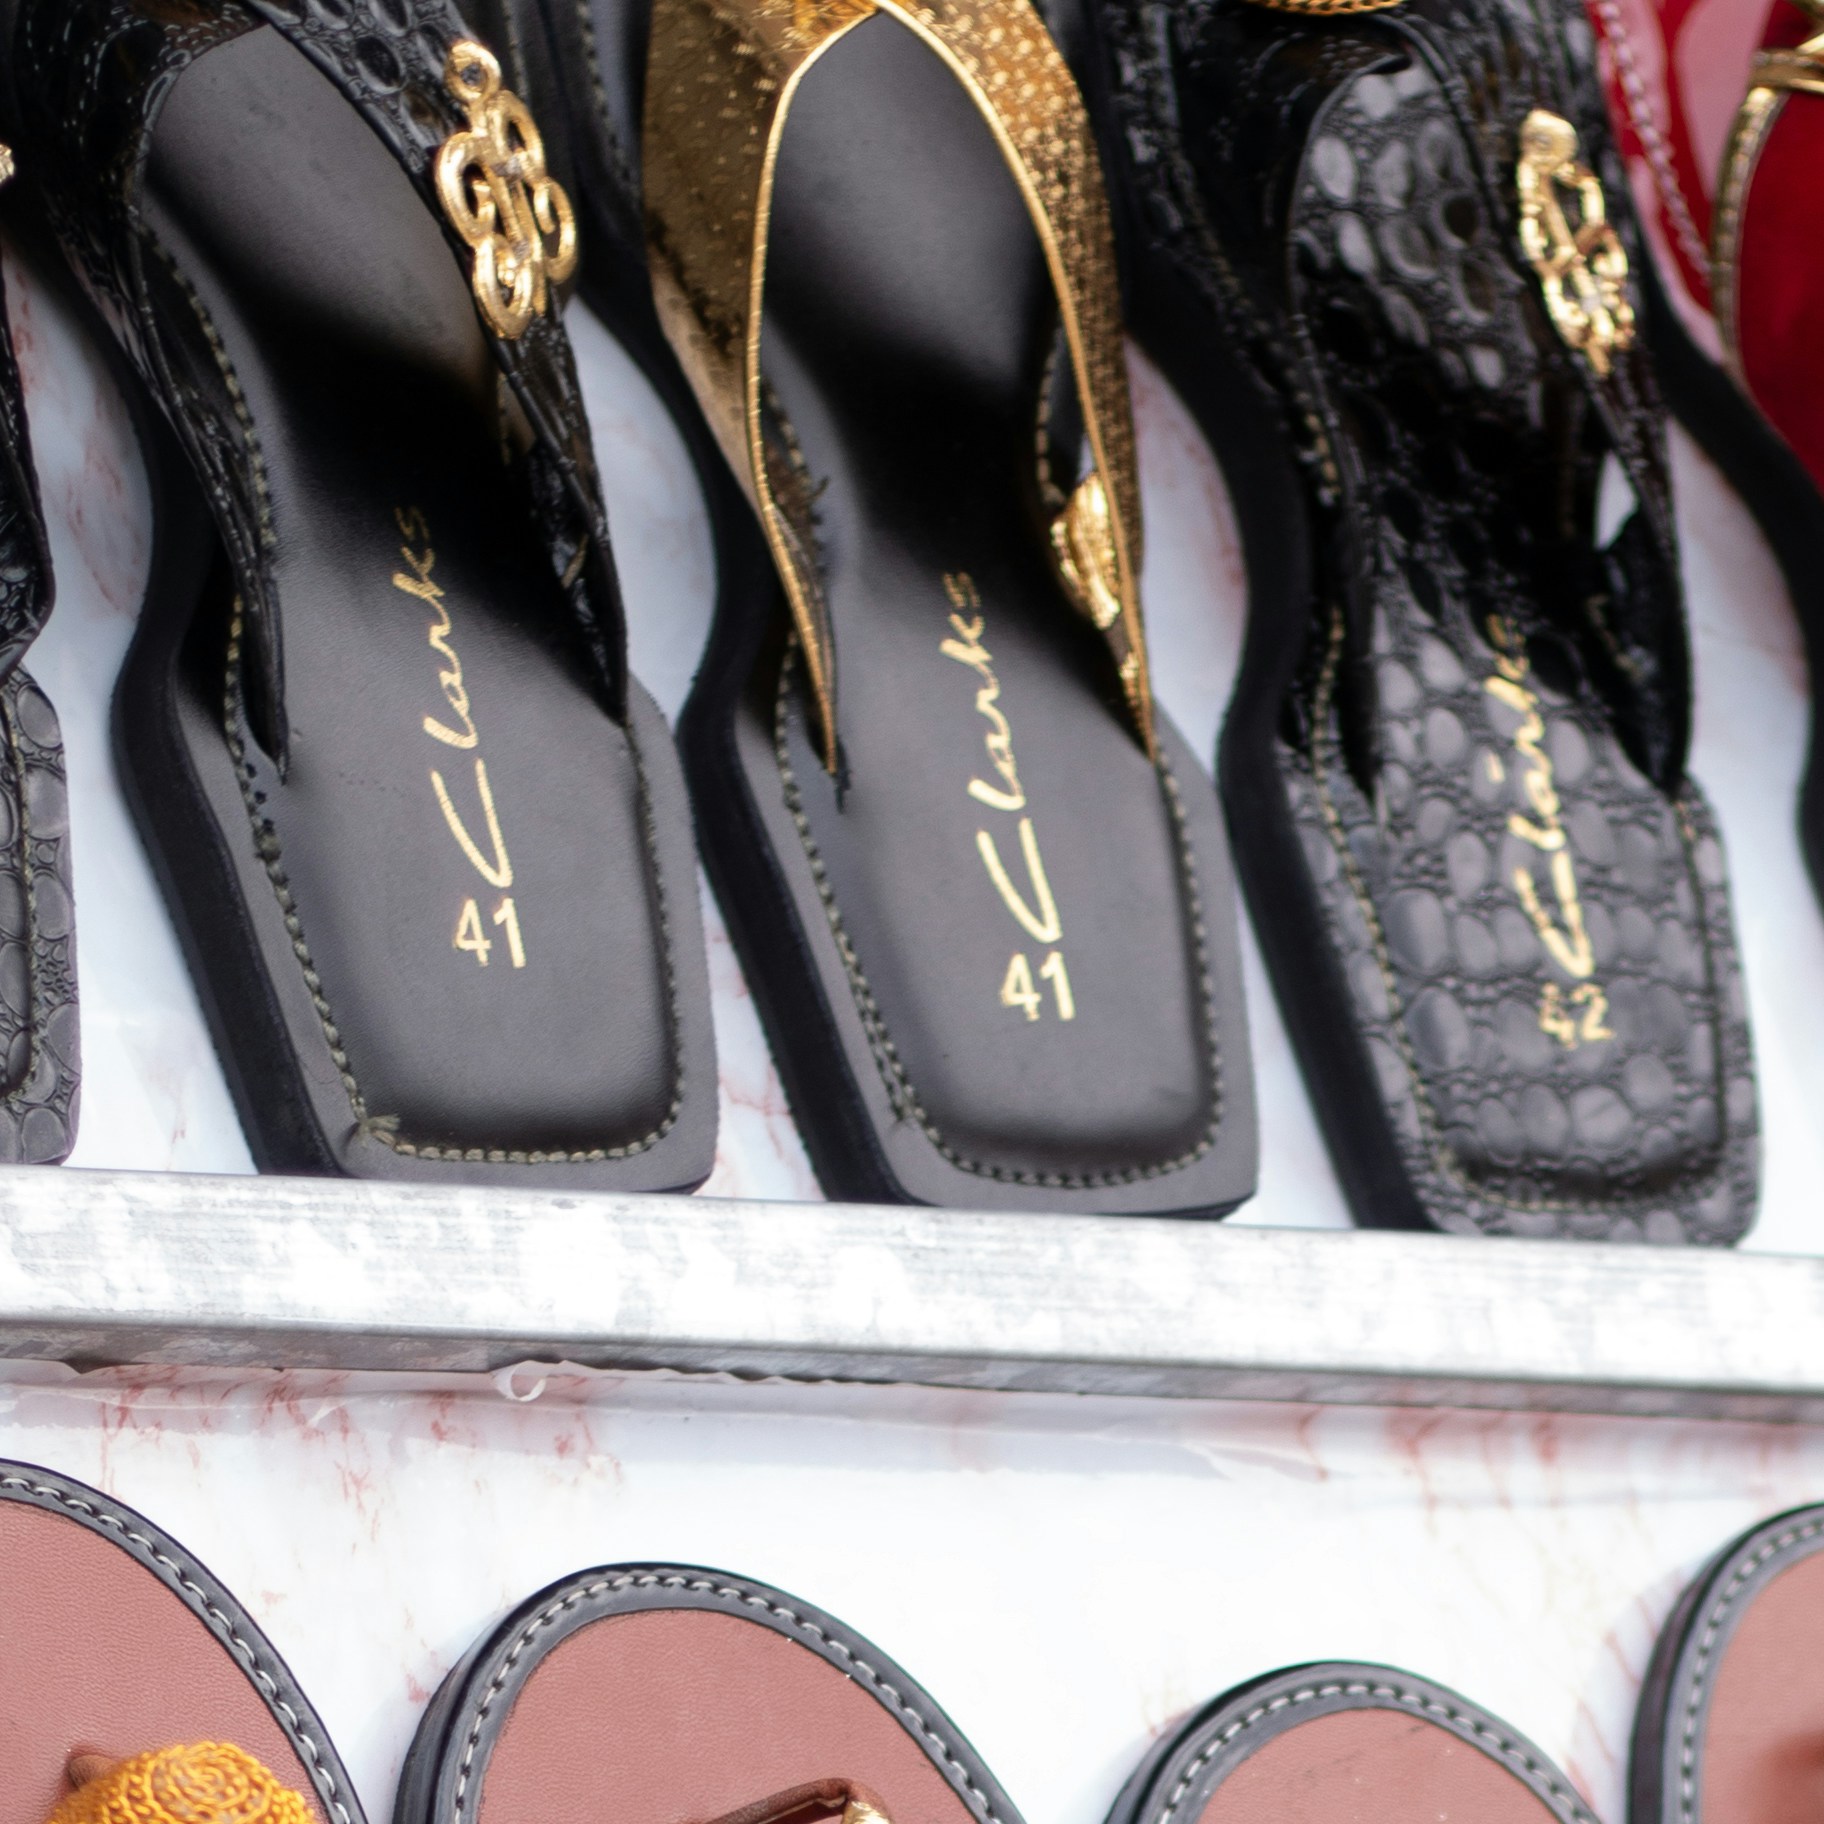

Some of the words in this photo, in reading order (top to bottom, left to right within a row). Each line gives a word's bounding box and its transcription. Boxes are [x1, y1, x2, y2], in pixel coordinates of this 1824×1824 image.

[393, 505, 514, 890] Clarks
[938, 570, 1063, 943] Clarks
[454, 898, 526, 970] 41
[1000, 952, 1076, 1021] 41
[1538, 981, 1616, 1052] 42
